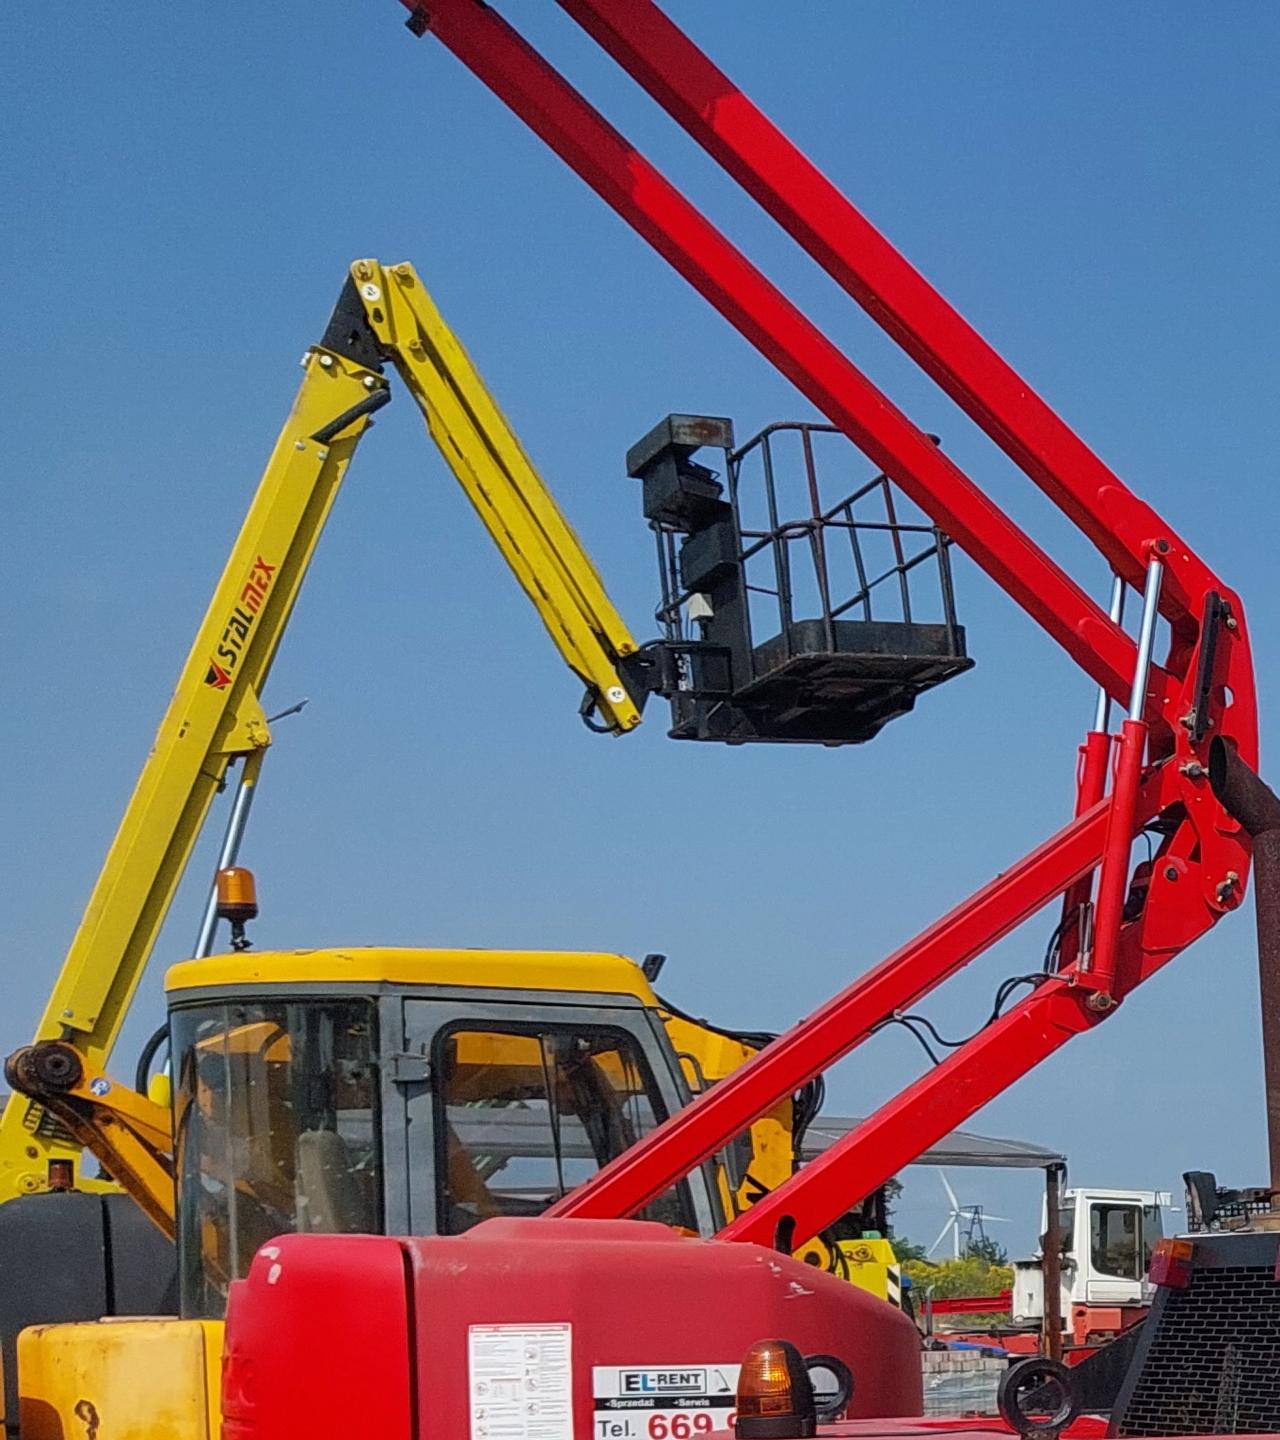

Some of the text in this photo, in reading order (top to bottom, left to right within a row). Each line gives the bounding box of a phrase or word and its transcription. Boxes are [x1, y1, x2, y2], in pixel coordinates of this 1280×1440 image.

[217, 556, 276, 668] STALMEX
[625, 1373, 701, 1392] EL-RENT
[597, 1420, 637, 1438] Tel.
[648, 1413, 713, 1440] 669
